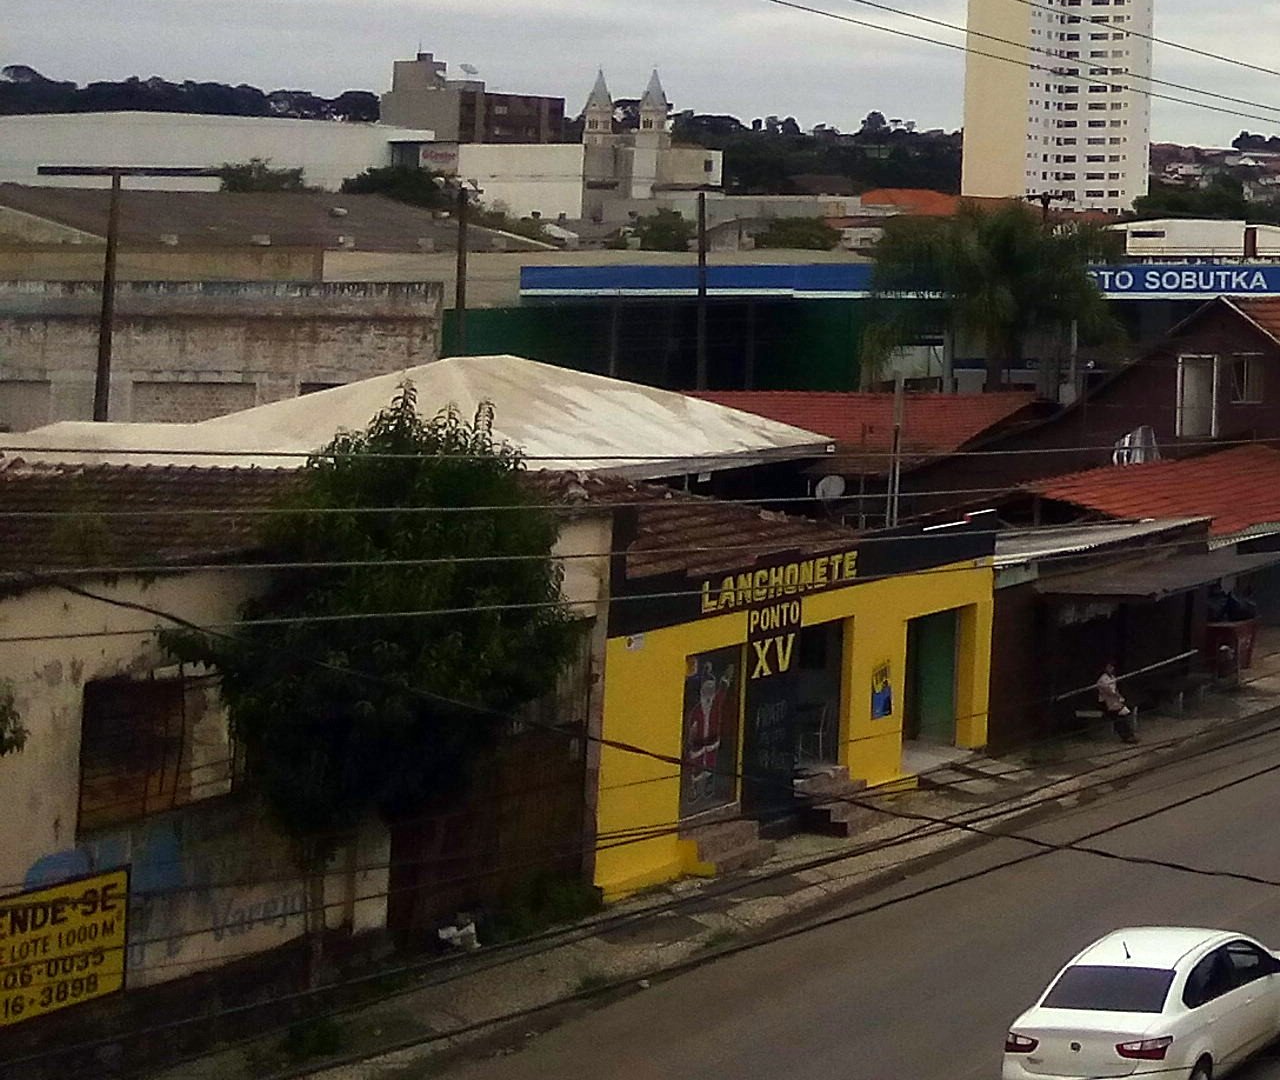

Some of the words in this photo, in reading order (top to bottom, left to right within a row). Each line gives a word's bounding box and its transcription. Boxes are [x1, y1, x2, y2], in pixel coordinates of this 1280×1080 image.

[1086, 271, 1133, 289] TO
[1144, 271, 1268, 290] SOBUTKA
[701, 551, 858, 614] LANCHONETE
[750, 600, 800, 633] PONTO
[751, 633, 796, 680] XV
[10, 935, 50, 964] LOTE
